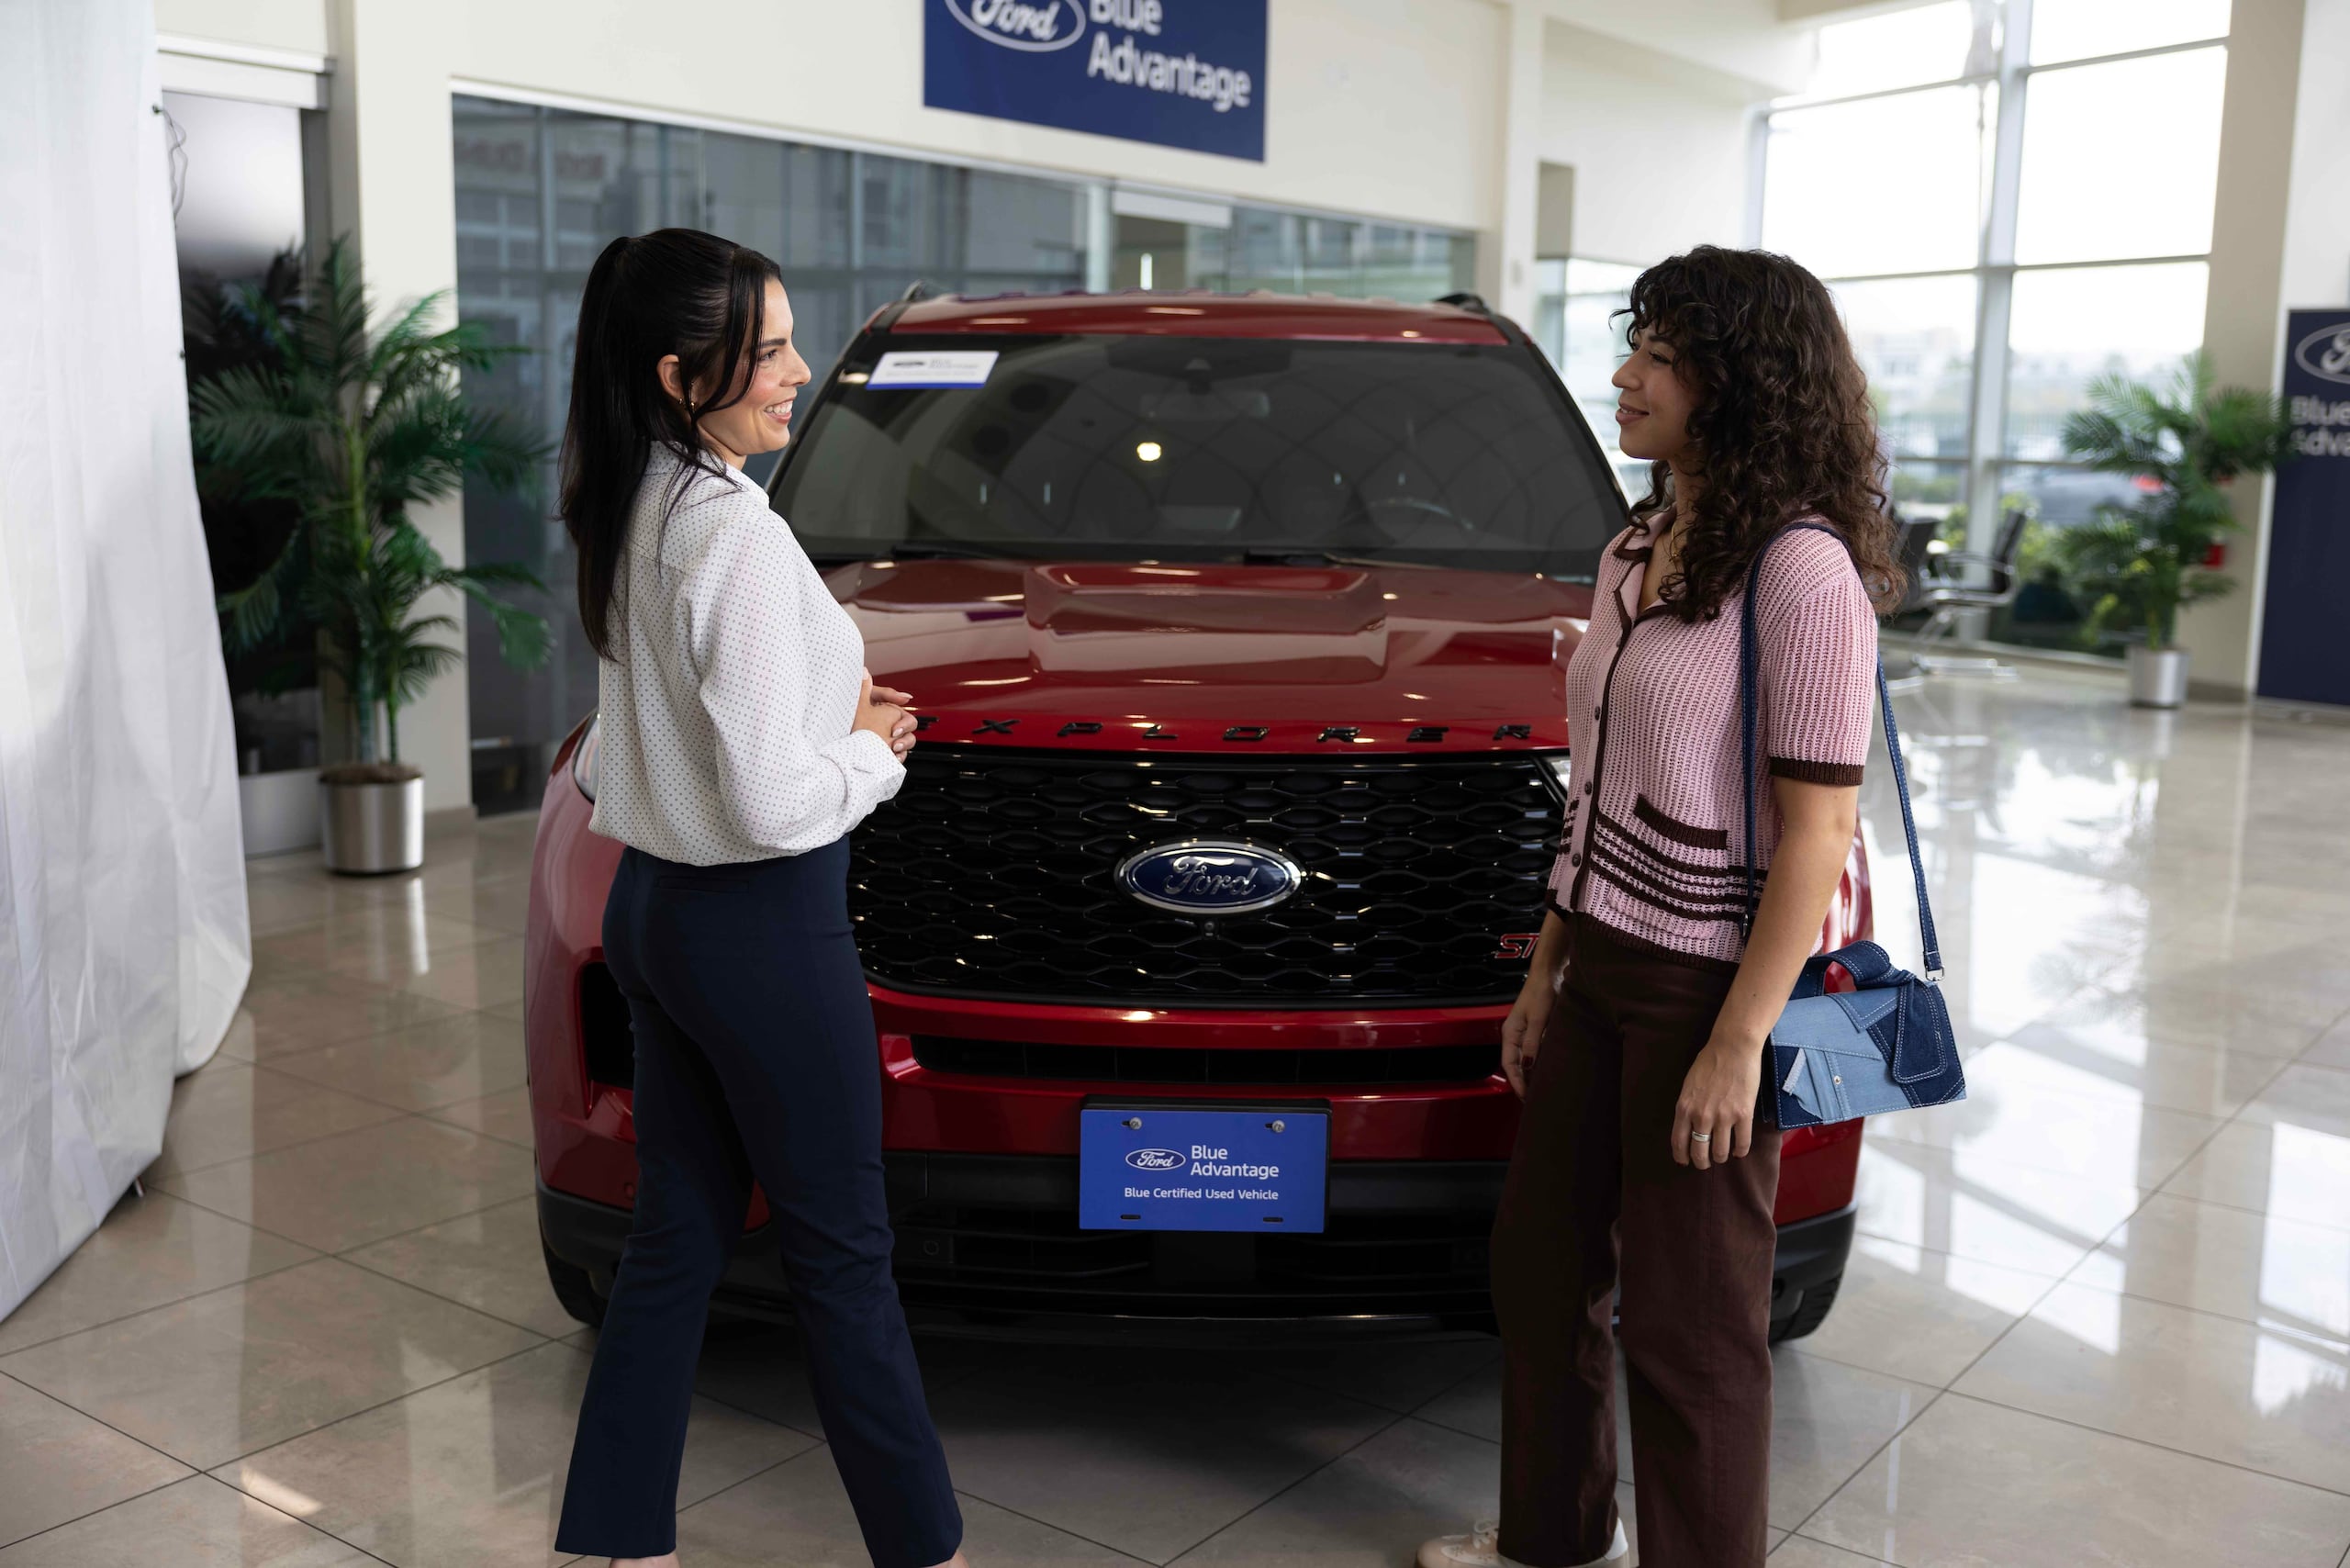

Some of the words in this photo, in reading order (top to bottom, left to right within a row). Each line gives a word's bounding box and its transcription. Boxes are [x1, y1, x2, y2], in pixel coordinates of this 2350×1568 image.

[1087, 31, 1252, 112] Advantage
[1163, 856, 1259, 895] Ford
[1136, 1150, 1175, 1168] Ford
[1191, 1145, 1228, 1159] Blue
[1190, 1162, 1280, 1180] Advantage
[1124, 1187, 1150, 1198] Blue
[1153, 1188, 1203, 1199] Certified
[1205, 1189, 1235, 1200] Used
[1237, 1190, 1280, 1200] Vehicle
